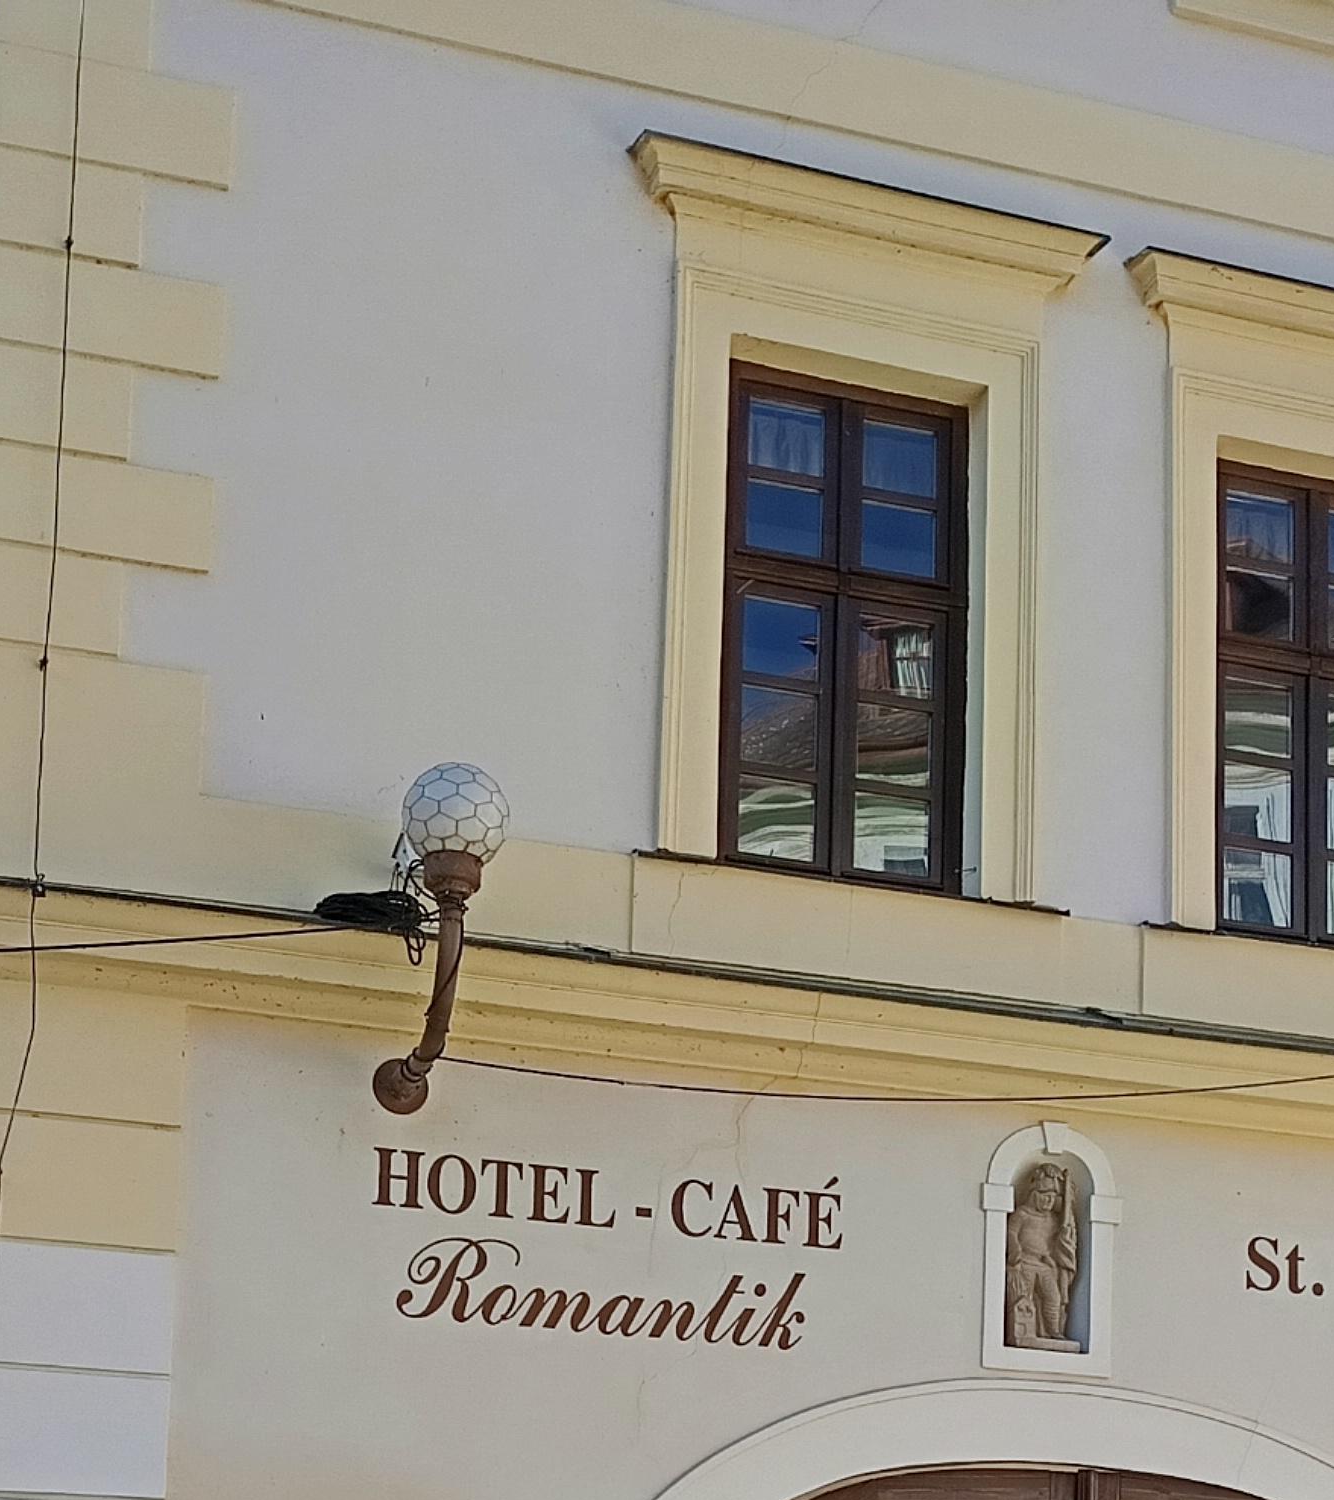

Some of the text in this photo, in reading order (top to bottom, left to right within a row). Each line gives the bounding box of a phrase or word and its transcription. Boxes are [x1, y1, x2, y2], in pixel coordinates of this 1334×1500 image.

[371, 1146, 616, 1228] HOTEL
[671, 1177, 844, 1250] CAFÉ
[396, 1236, 807, 1351] Romantik
[1245, 1236, 1325, 1297] St.
